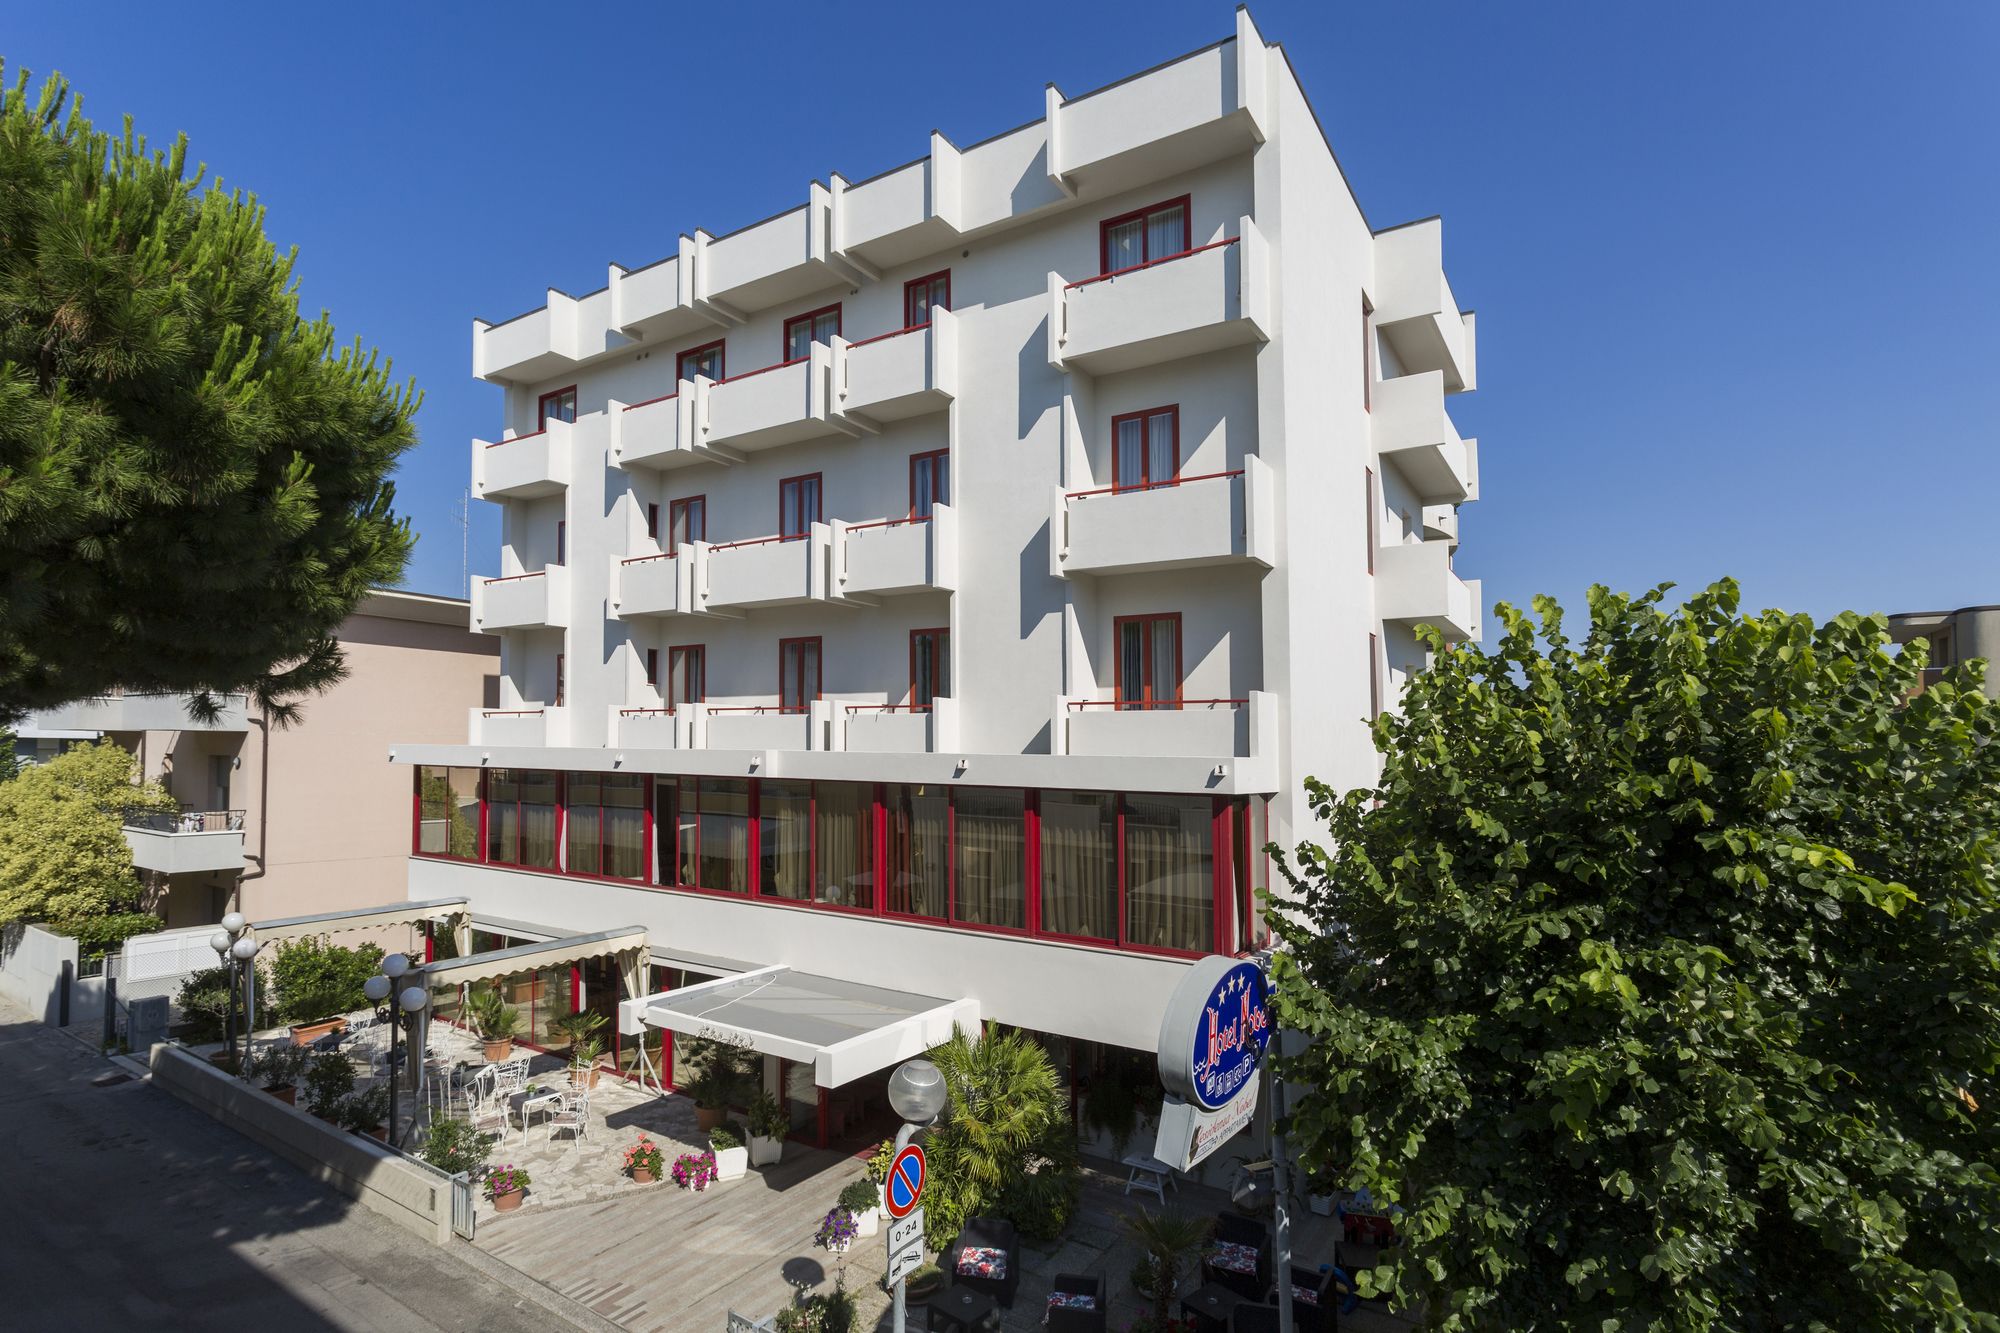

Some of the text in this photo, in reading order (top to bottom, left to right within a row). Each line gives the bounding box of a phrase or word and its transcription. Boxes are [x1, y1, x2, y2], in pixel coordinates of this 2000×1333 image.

[1200, 981, 1268, 1083] Hotel Nobe
[1244, 1057, 1250, 1073] P
[895, 1220, 917, 1242] 0-24
